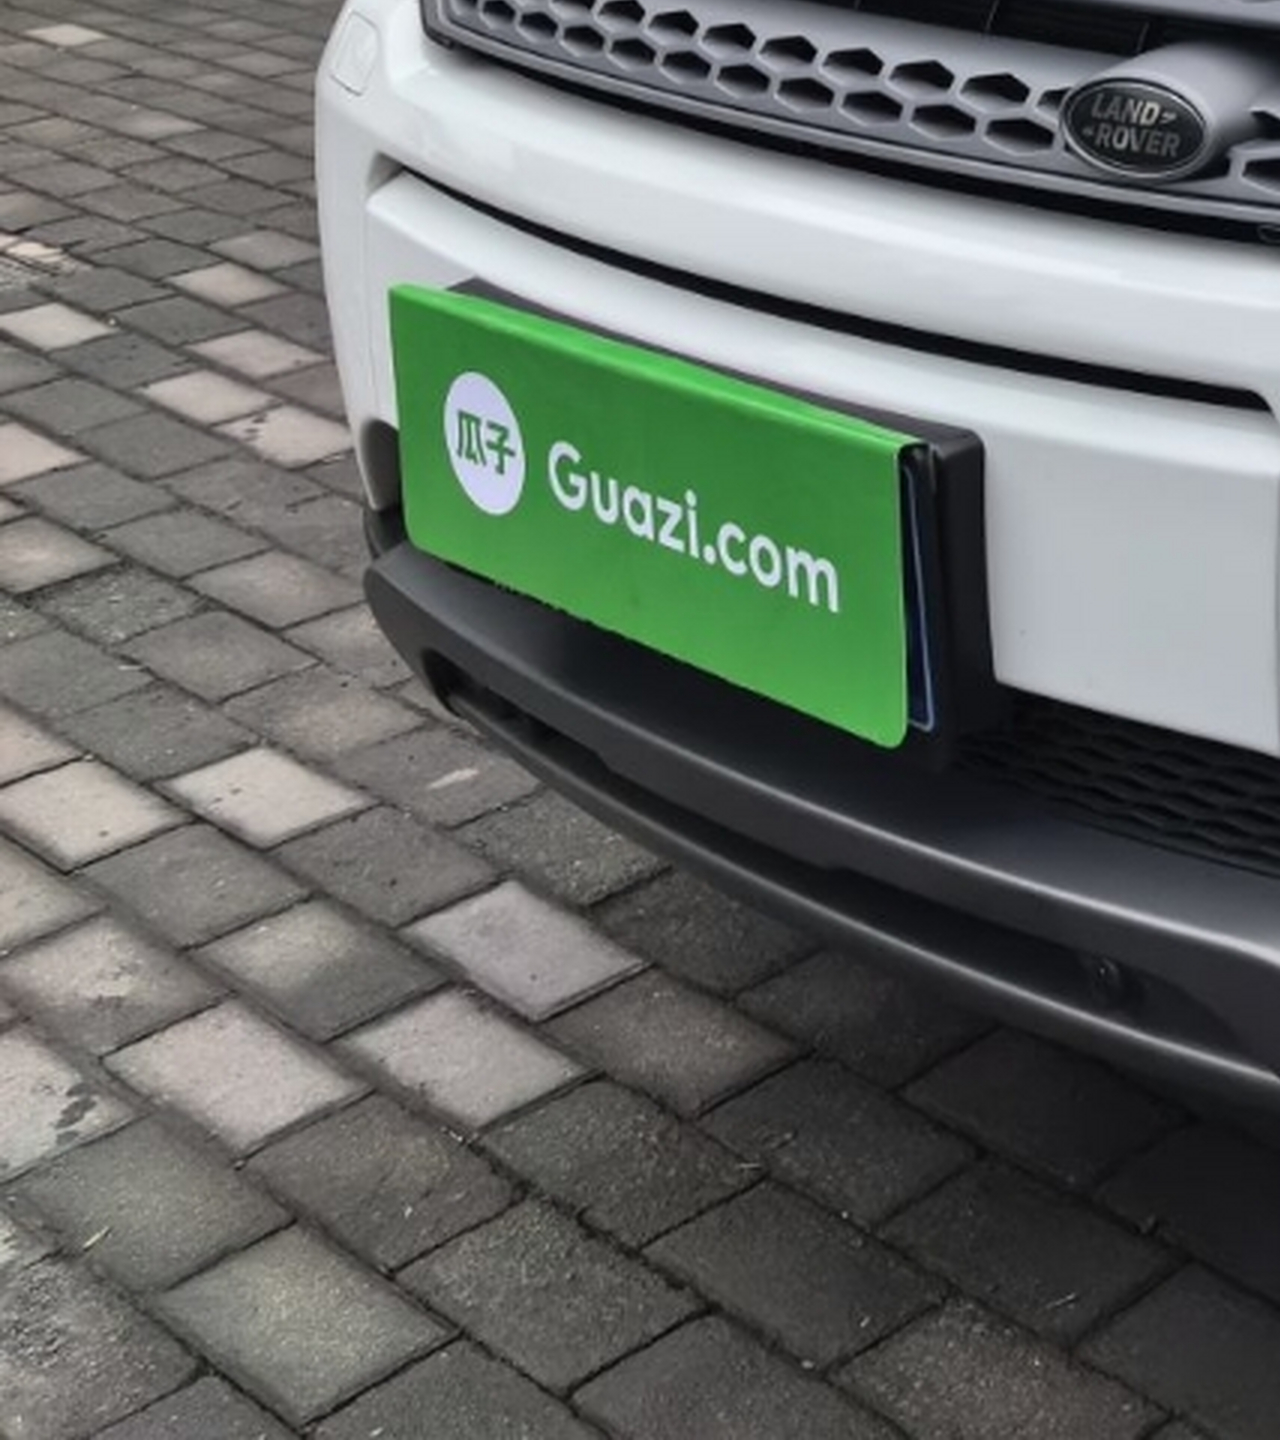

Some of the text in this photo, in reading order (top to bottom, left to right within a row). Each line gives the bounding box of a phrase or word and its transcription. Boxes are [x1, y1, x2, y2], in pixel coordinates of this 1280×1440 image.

[1091, 92, 1161, 127] LAND
[1094, 122, 1181, 158] ROVER
[456, 409, 517, 475] 瓜子
[547, 440, 840, 613] Guazi.com
